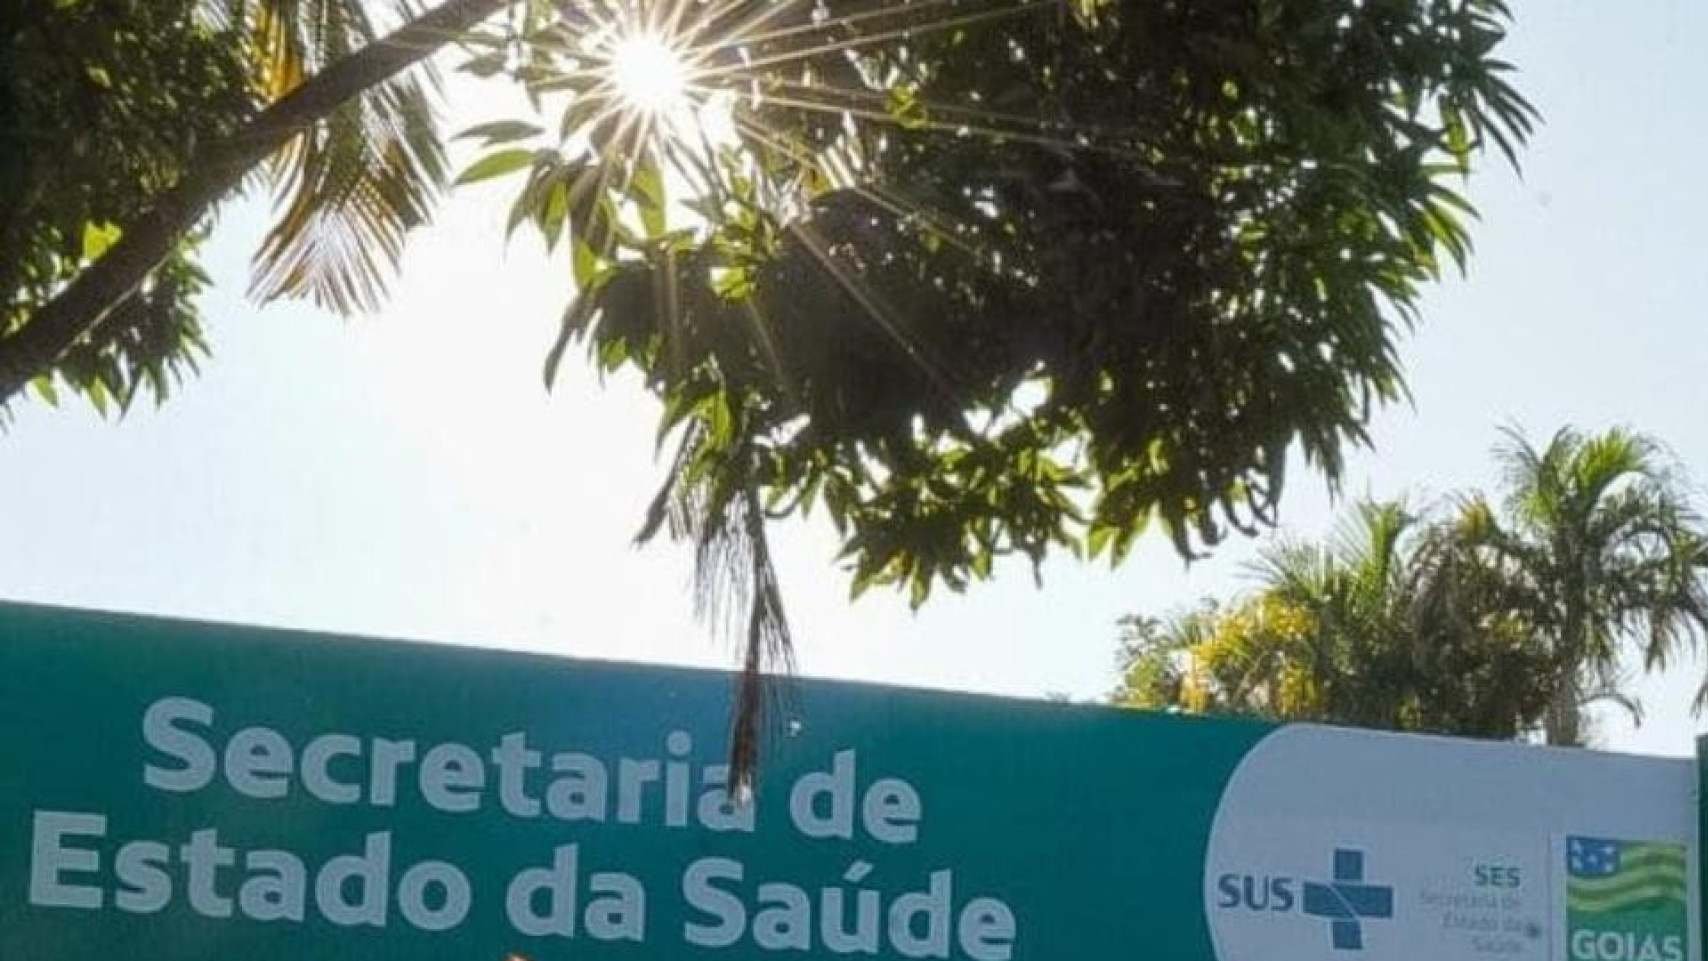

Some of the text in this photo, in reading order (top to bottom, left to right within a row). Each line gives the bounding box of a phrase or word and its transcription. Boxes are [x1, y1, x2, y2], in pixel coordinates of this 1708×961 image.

[142, 696, 922, 844] Secretaria de
[28, 810, 473, 933] Estado
[505, 843, 646, 943] da
[1217, 873, 1295, 912] SUS
[1474, 863, 1521, 888] SES
